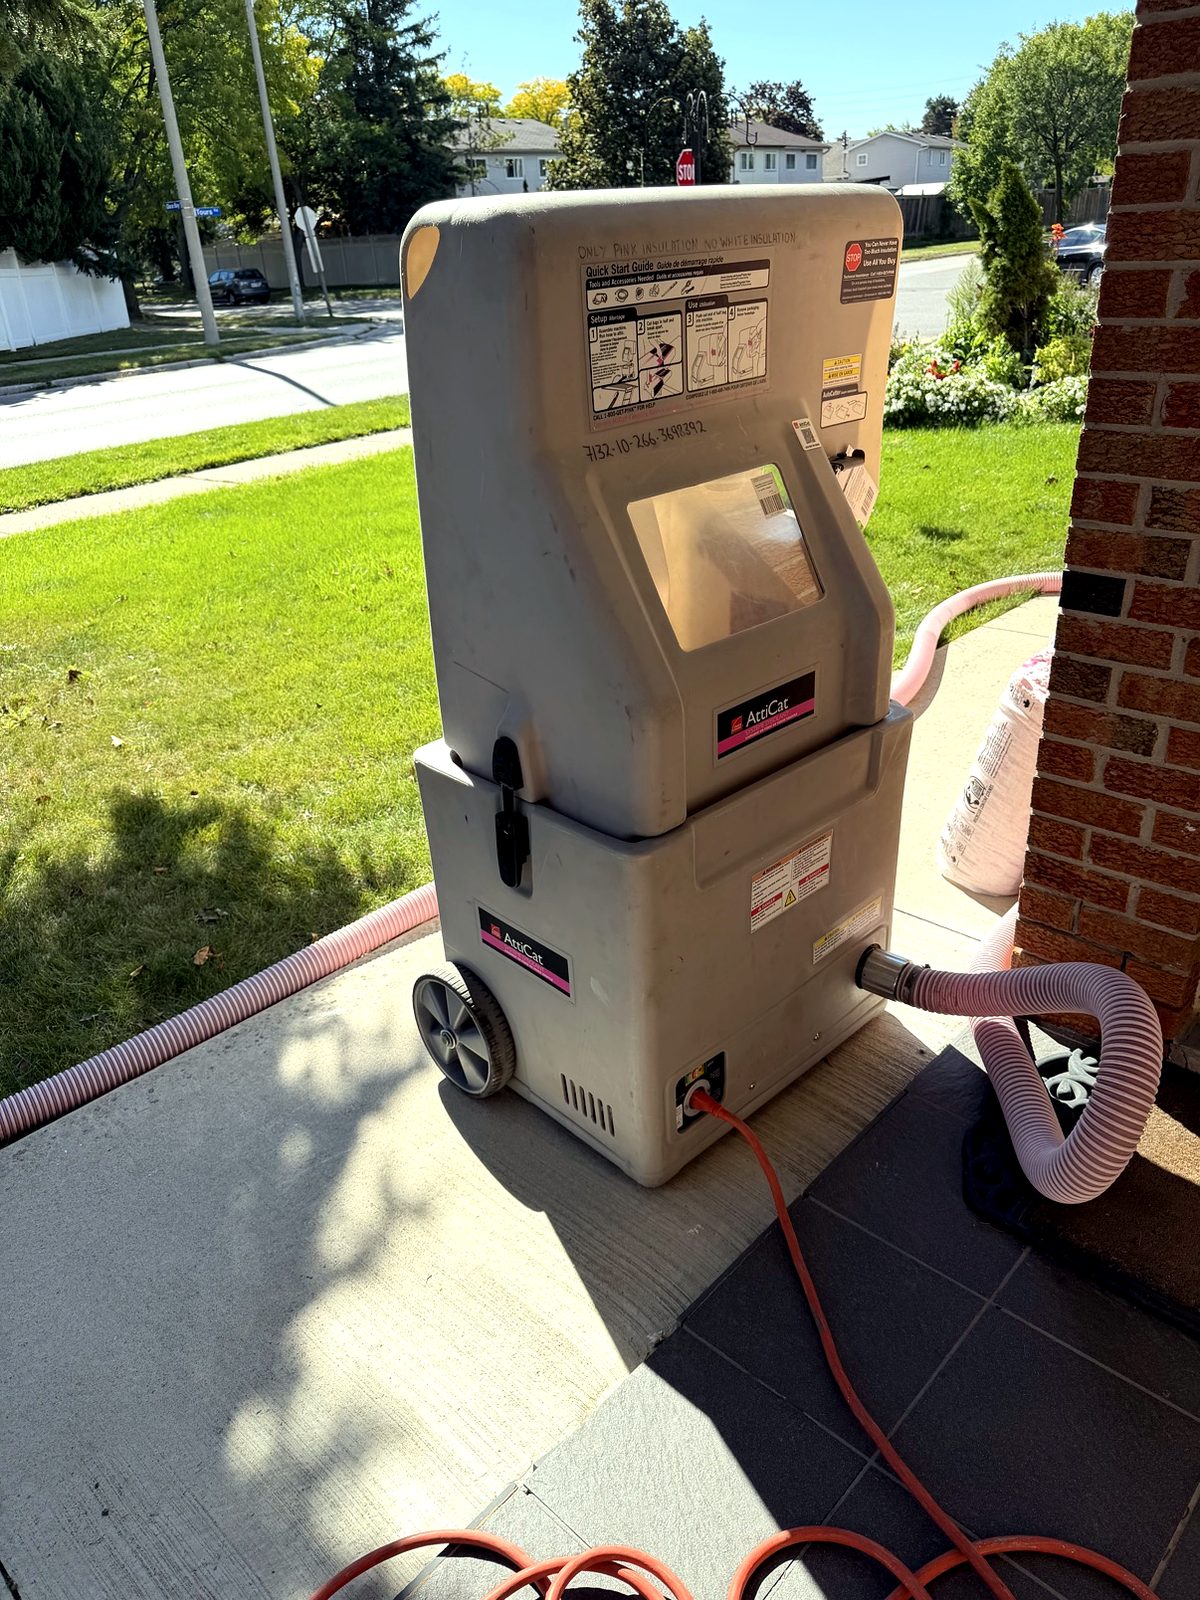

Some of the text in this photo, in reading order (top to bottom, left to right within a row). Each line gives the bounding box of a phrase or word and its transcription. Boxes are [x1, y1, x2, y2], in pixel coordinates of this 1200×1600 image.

[578, 245, 606, 260] ONLY
[642, 238, 698, 255] INSULATION
[704, 240, 718, 250] NO
[721, 234, 749, 249] WHITE
[750, 231, 796, 245] INSULATION
[846, 253, 861, 263] STOP
[586, 264, 609, 278] Quick
[611, 262, 630, 275] Start
[632, 260, 654, 273] Guide
[657, 260, 672, 270] Guide
[673, 259, 680, 268] de
[589, 280, 601, 289] Tools
[601, 279, 611, 287] and
[611, 276, 637, 286] Accessories
[637, 275, 654, 283] Needed
[688, 300, 699, 309] Use
[590, 313, 608, 324] Setup
[593, 413, 603, 421] CALL
[745, 697, 790, 728] AttiCat
[503, 932, 544, 966] AttiCat
